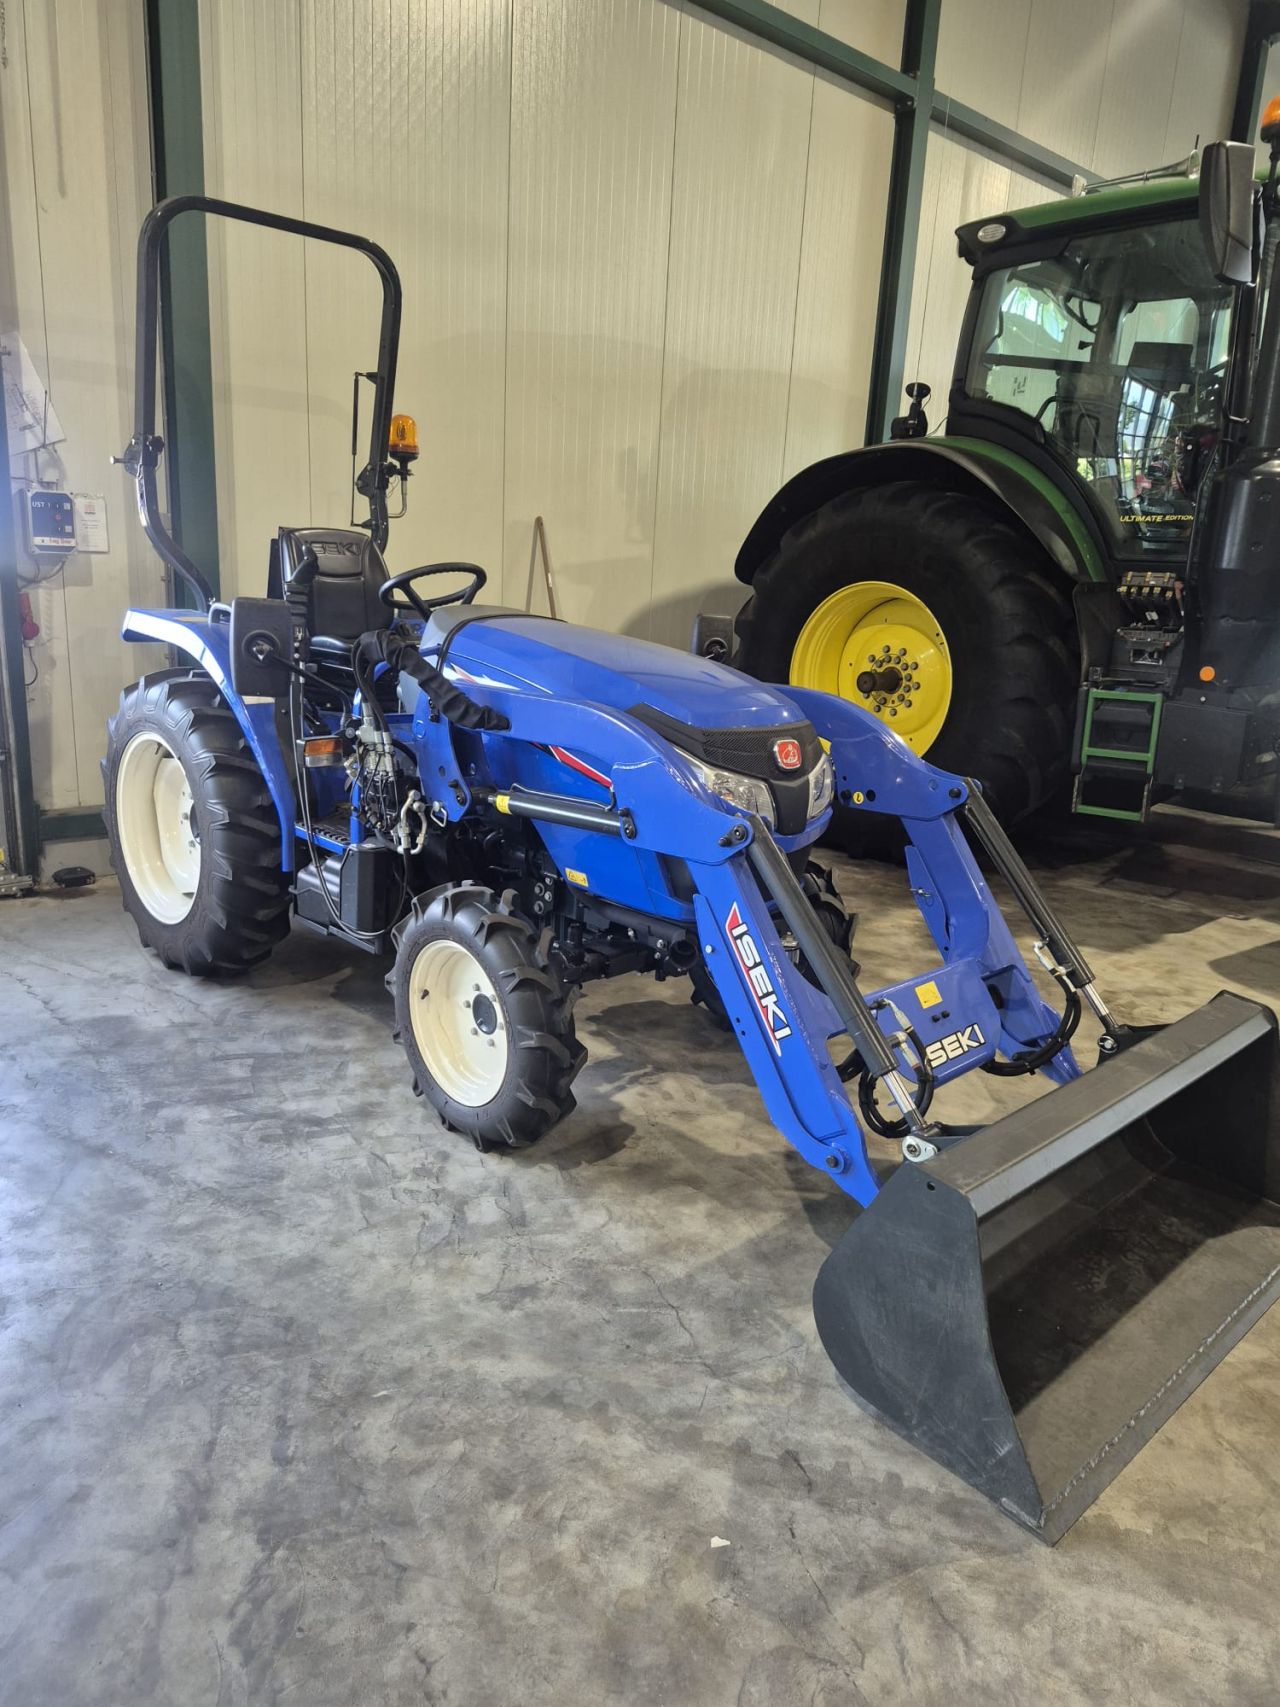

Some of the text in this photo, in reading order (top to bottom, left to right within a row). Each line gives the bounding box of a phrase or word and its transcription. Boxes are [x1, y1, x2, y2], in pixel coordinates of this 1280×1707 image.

[310, 541, 361, 556] SEKI
[731, 922, 793, 1041] ISEKI
[925, 1022, 986, 1069] SEKI
